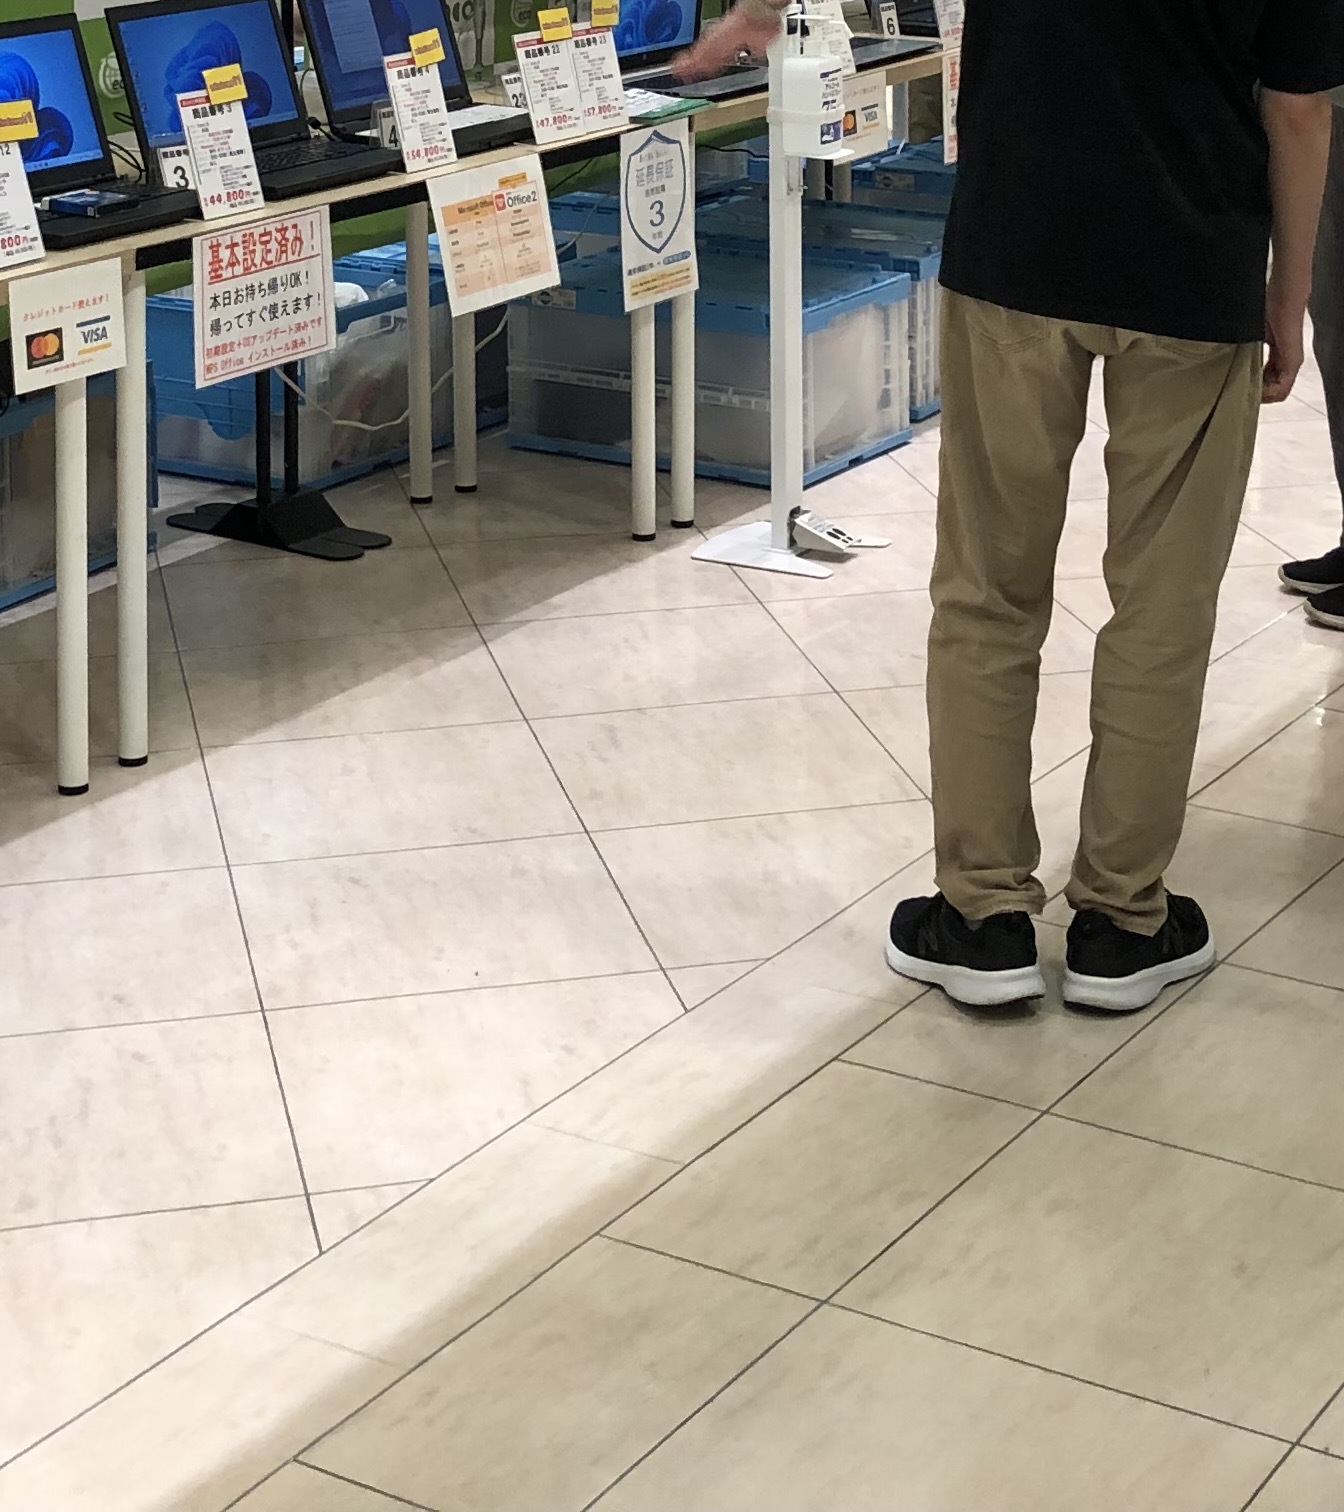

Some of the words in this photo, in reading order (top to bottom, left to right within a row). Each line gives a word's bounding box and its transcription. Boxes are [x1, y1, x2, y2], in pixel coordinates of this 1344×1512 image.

[886, 17, 896, 36] 6
[551, 44, 561, 55] 22
[388, 124, 399, 148] 4
[173, 165, 190, 189] 3
[209, 188, 253, 206] 44,800円
[506, 190, 538, 208] Office2
[649, 199, 665, 228] 3
[207, 219, 316, 281] 基本設定済み!
[208, 270, 310, 312] 本日お持ち帰りOK!
[209, 292, 322, 338] 帰ってすぐ使えます!
[81, 325, 109, 345] VISA
